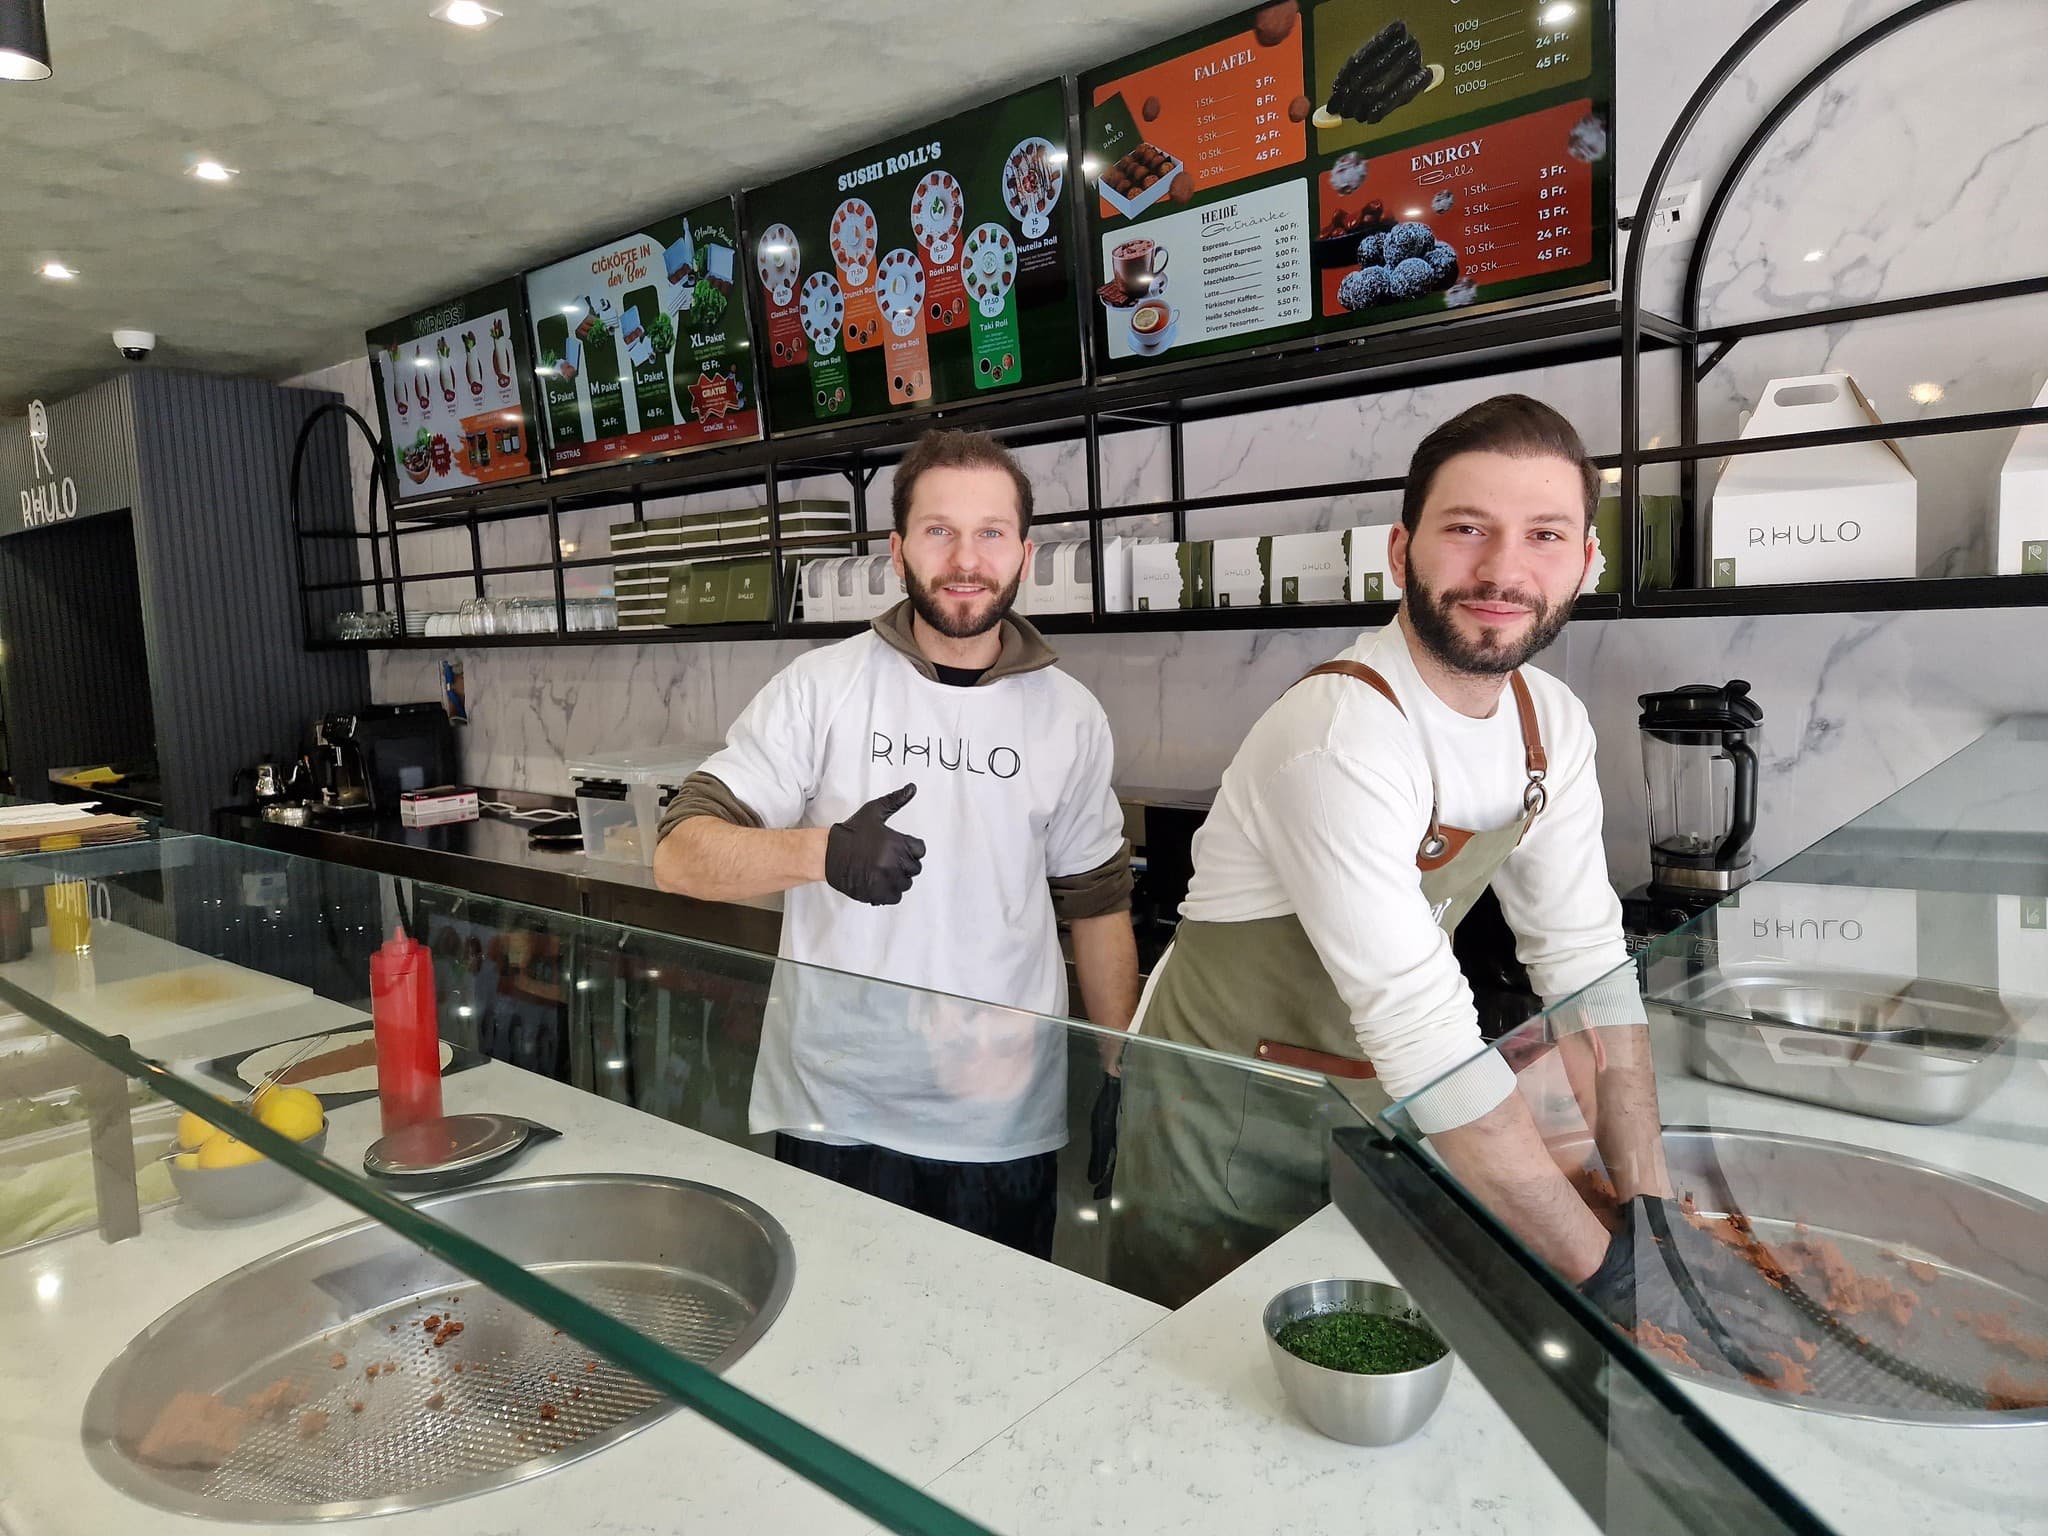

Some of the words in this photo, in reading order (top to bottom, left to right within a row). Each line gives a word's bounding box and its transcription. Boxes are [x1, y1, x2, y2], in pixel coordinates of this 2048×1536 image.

[1453, 17, 1479, 35] 100g
[1454, 38, 1481, 55] 250g
[1454, 58, 1482, 76] 500g
[1536, 35, 1551, 49] 24
[1554, 31, 1570, 43] Fr.
[1193, 49, 1256, 81] FALAFEL
[1454, 78, 1488, 96] 1000g
[1536, 55, 1551, 69] 45
[1554, 52, 1570, 65] Fr.
[1256, 79, 1262, 88] 3
[1264, 75, 1276, 86] Fr.
[1256, 97, 1262, 106] 8
[1265, 94, 1277, 105] Fr.
[1267, 112, 1279, 122] Fr.
[1198, 151, 1207, 161] 10
[1255, 133, 1267, 144] 24
[1269, 130, 1281, 140] Fr.
[1411, 139, 1483, 172] ENERGY
[1199, 168, 1209, 179] 20
[1256, 151, 1268, 161] 45
[1270, 148, 1282, 158] Fr.
[1540, 168, 1548, 179] 3
[1551, 165, 1567, 177] Fr.
[838, 161, 884, 191] SUSHI
[1412, 164, 1474, 186] Balls
[1464, 207, 1470, 217] 3
[1540, 189, 1548, 199] 8
[1551, 186, 1567, 197] Fr.
[1464, 226, 1471, 236] 5
[1538, 209, 1550, 220] 13
[1553, 206, 1569, 217] Fr.
[640, 243, 651, 259] IN
[1017, 241, 1043, 254] Nutella
[1043, 236, 1058, 248] Roll
[1465, 245, 1475, 256] 10
[1537, 229, 1552, 241] 24
[1555, 226, 1571, 238] Fr.
[946, 263, 959, 273] Roll
[1466, 265, 1478, 275] 20
[1537, 249, 1552, 261] 45
[1555, 246, 1571, 258] Fr.
[608, 270, 624, 288] der
[624, 260, 647, 283] Box
[995, 318, 1008, 328] Roll
[690, 333, 705, 348] XL
[705, 332, 726, 345] Paket
[702, 361, 710, 371] 65
[590, 381, 601, 395] M
[601, 382, 620, 393] Paket
[636, 371, 644, 385] L
[644, 371, 664, 383] Paket
[550, 391, 557, 404] S
[557, 391, 575, 401] Paket
[21, 476, 78, 529] RHULO
[1749, 520, 1861, 548] RHULO
[871, 731, 1021, 780] RHULO
